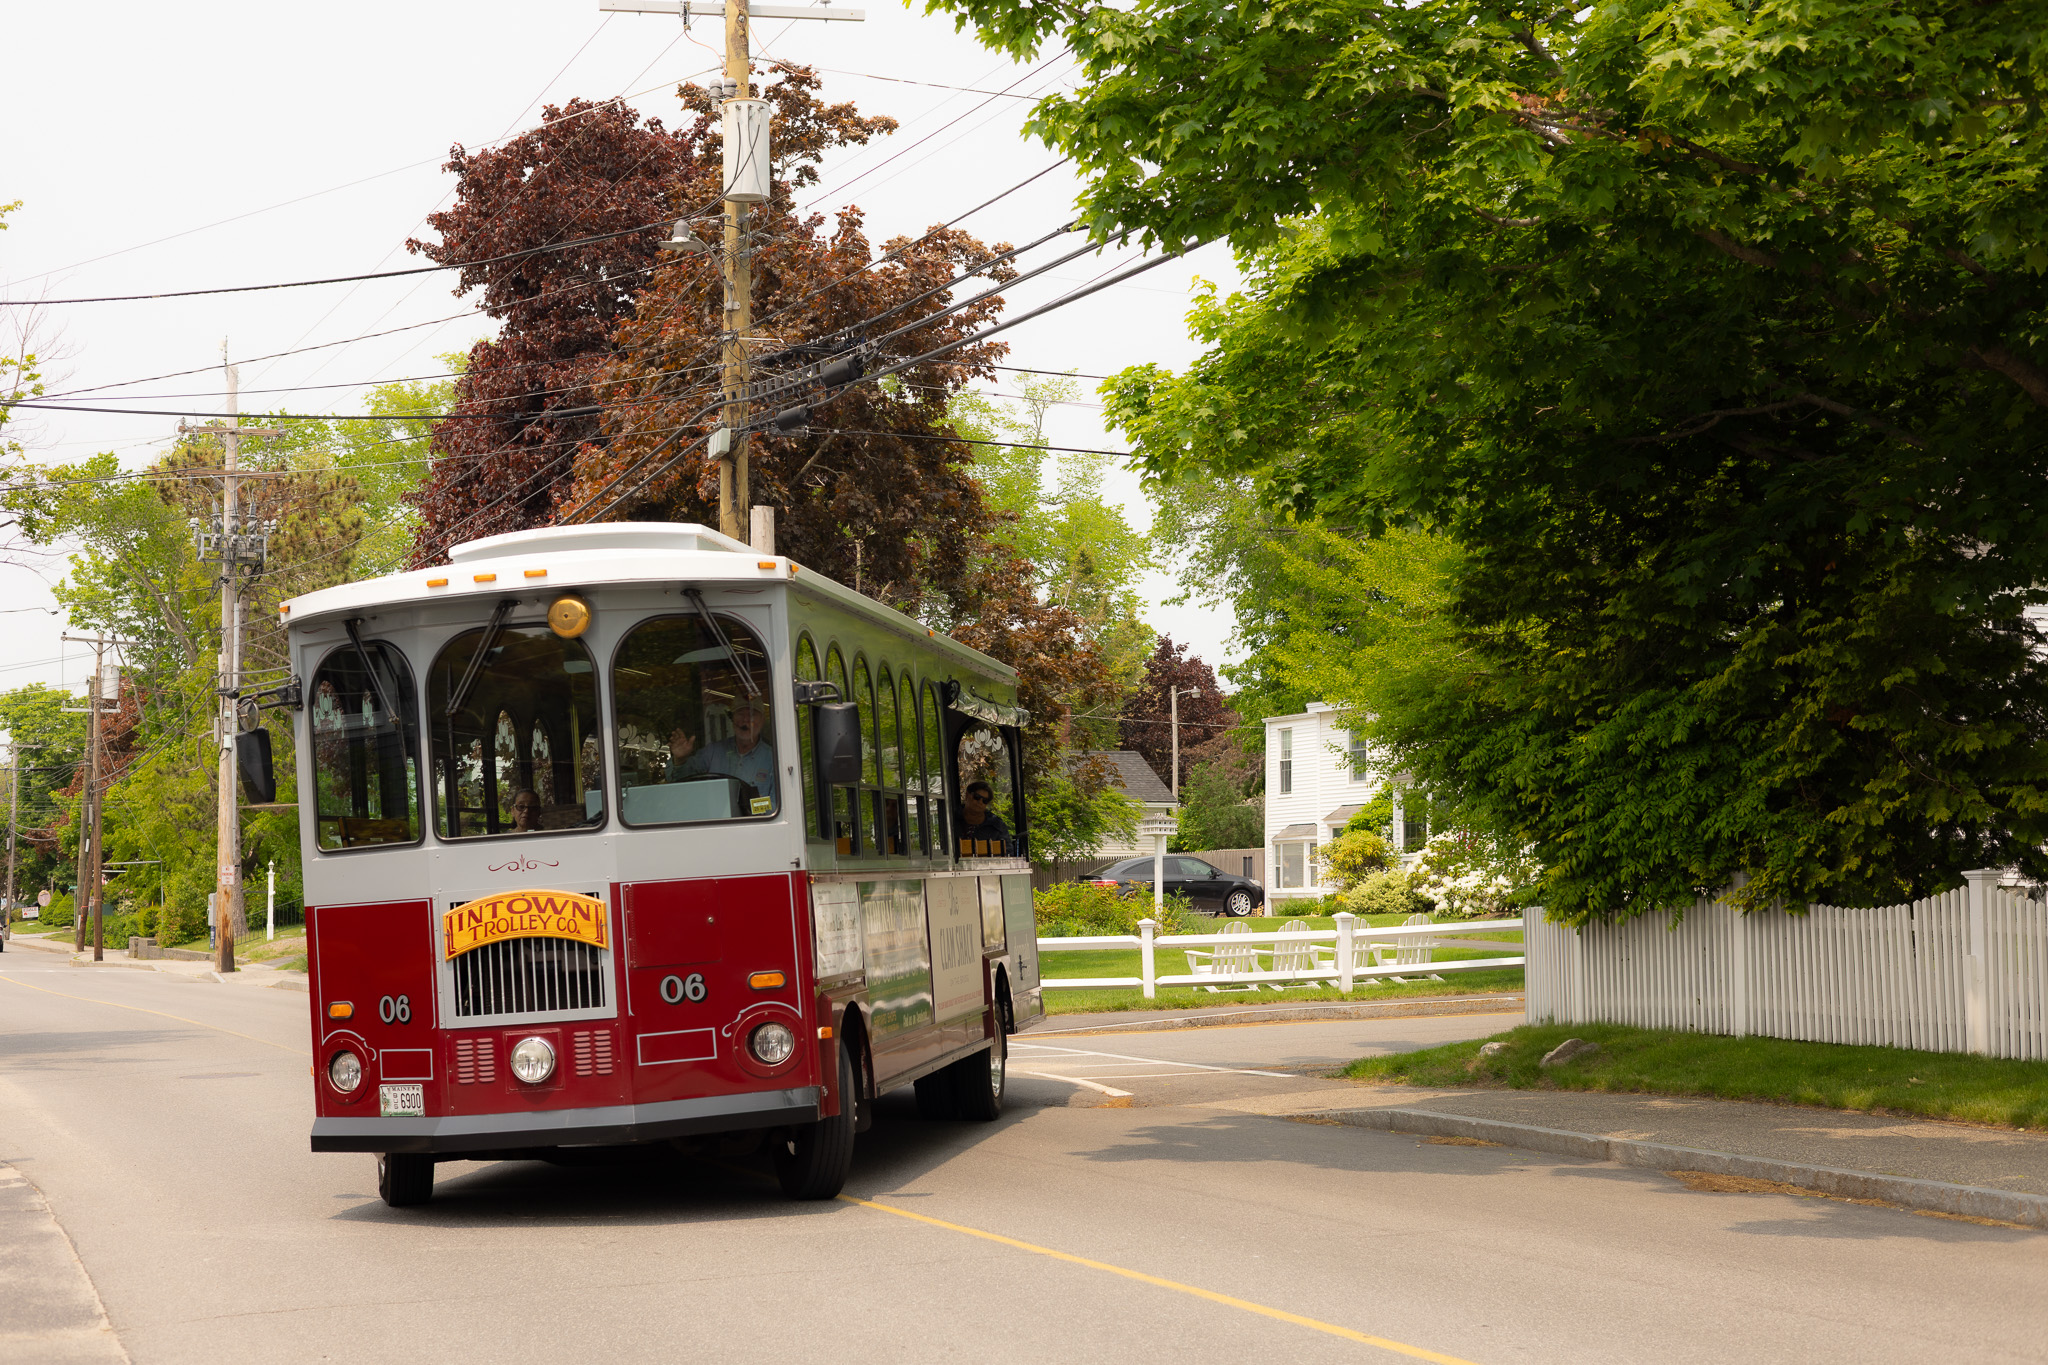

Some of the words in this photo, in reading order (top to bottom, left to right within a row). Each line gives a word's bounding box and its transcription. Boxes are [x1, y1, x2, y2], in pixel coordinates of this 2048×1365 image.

[458, 896, 591, 932] INTOWN
[468, 914, 552, 941] TROLLEY
[556, 916, 581, 935] CO.
[659, 972, 708, 1005] 06
[379, 993, 412, 1025] 06
[400, 1092, 422, 1109] 6900
